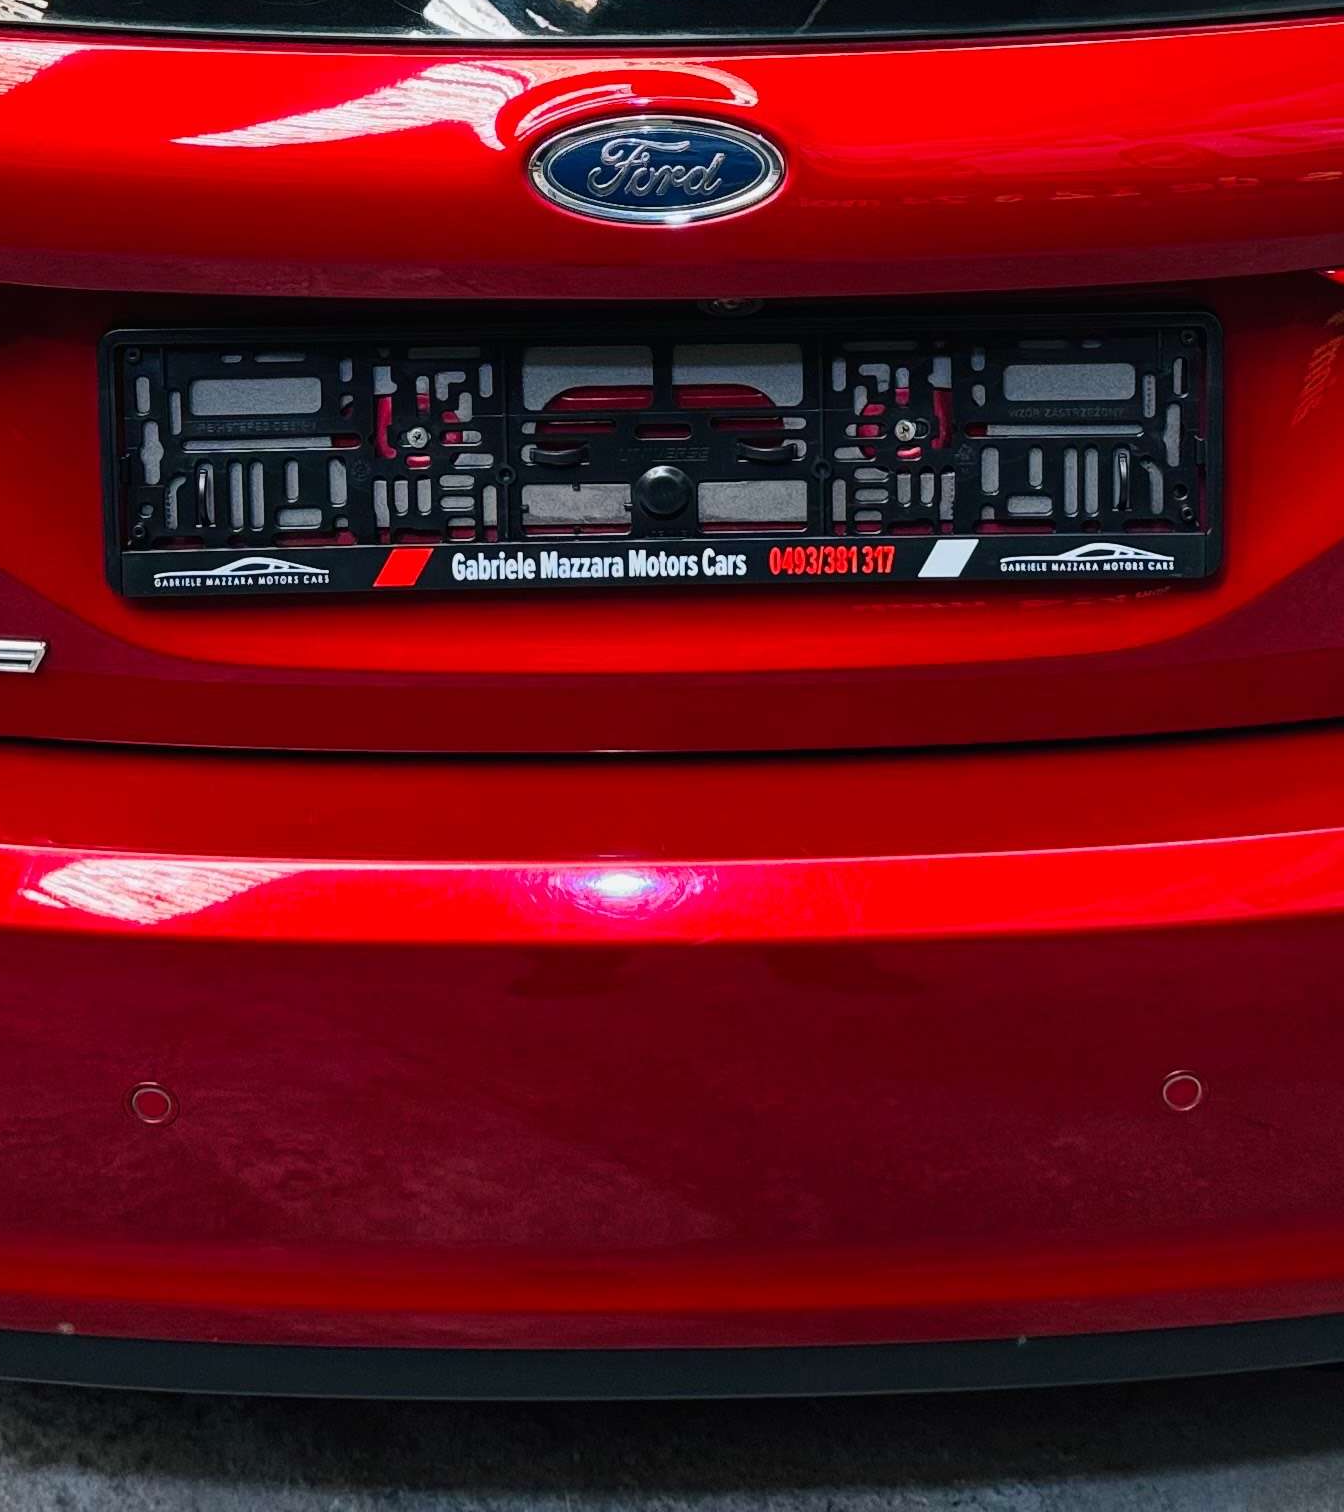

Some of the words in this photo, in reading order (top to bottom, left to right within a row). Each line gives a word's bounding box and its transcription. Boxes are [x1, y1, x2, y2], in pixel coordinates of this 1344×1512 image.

[587, 137, 726, 197] Ford
[452, 551, 536, 581] Gabriele
[539, 550, 624, 579] Mazzara
[628, 549, 699, 578] Motors
[702, 547, 747, 577] Cars
[769, 545, 858, 575] 0493/381
[861, 545, 896, 574] 317
[1000, 562, 1047, 571] GABRIELE
[1051, 562, 1099, 571] MAZZARA
[1103, 561, 1144, 571] MOTORS
[1147, 561, 1175, 571] CARS
[154, 577, 202, 588] GABRIELE
[205, 576, 254, 586] MAZZARA
[258, 575, 299, 586] MOTORS
[303, 574, 330, 584] CARS
